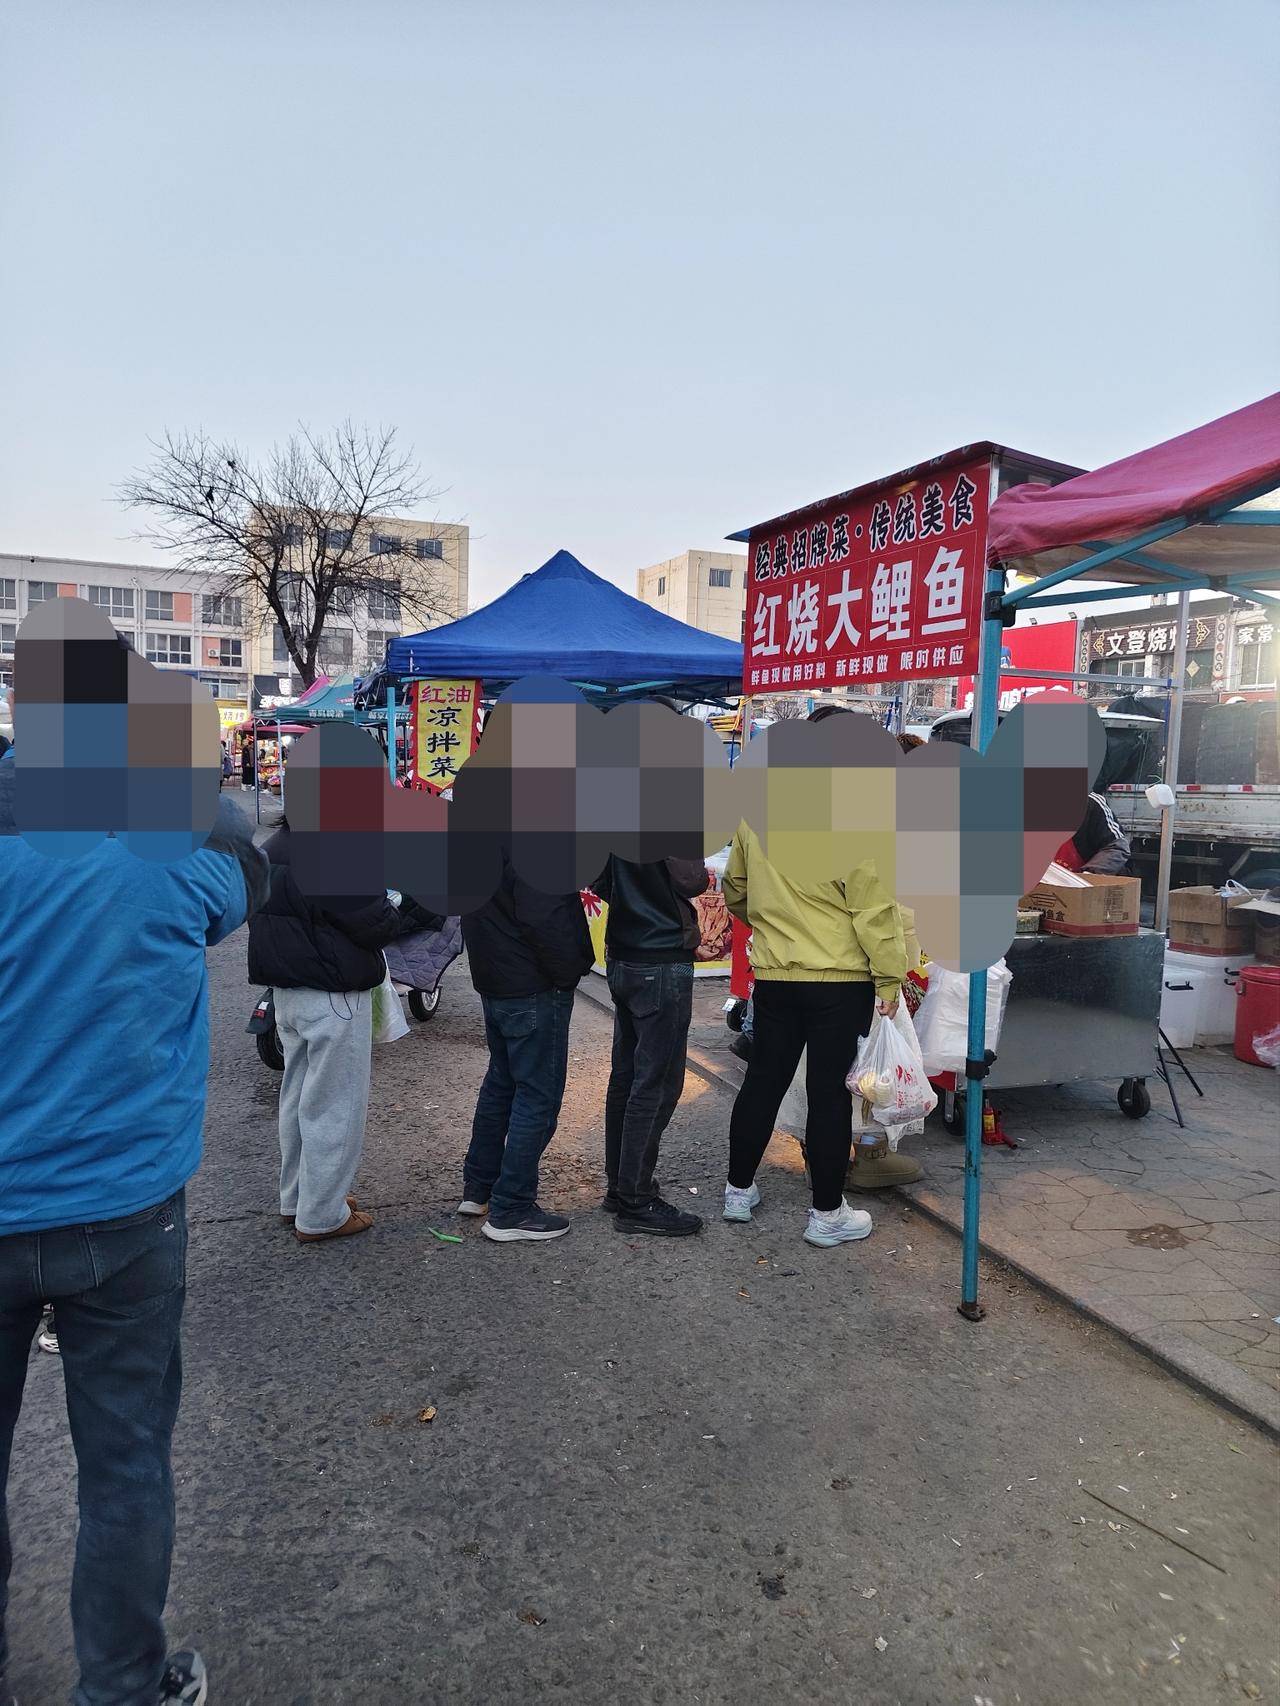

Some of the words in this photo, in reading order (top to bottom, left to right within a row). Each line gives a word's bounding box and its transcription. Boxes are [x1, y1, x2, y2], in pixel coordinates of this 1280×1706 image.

[755, 474, 977, 582] 经典招牌菜·传统美食
[752, 545, 966, 658] 红烧大鲤鱼
[1238, 624, 1280, 645] 家常
[835, 654, 889, 677] 新鲜现做
[900, 645, 964, 670] 限时供应
[420, 685, 471, 703] 红油
[427, 706, 462, 777] 凉拌菜
